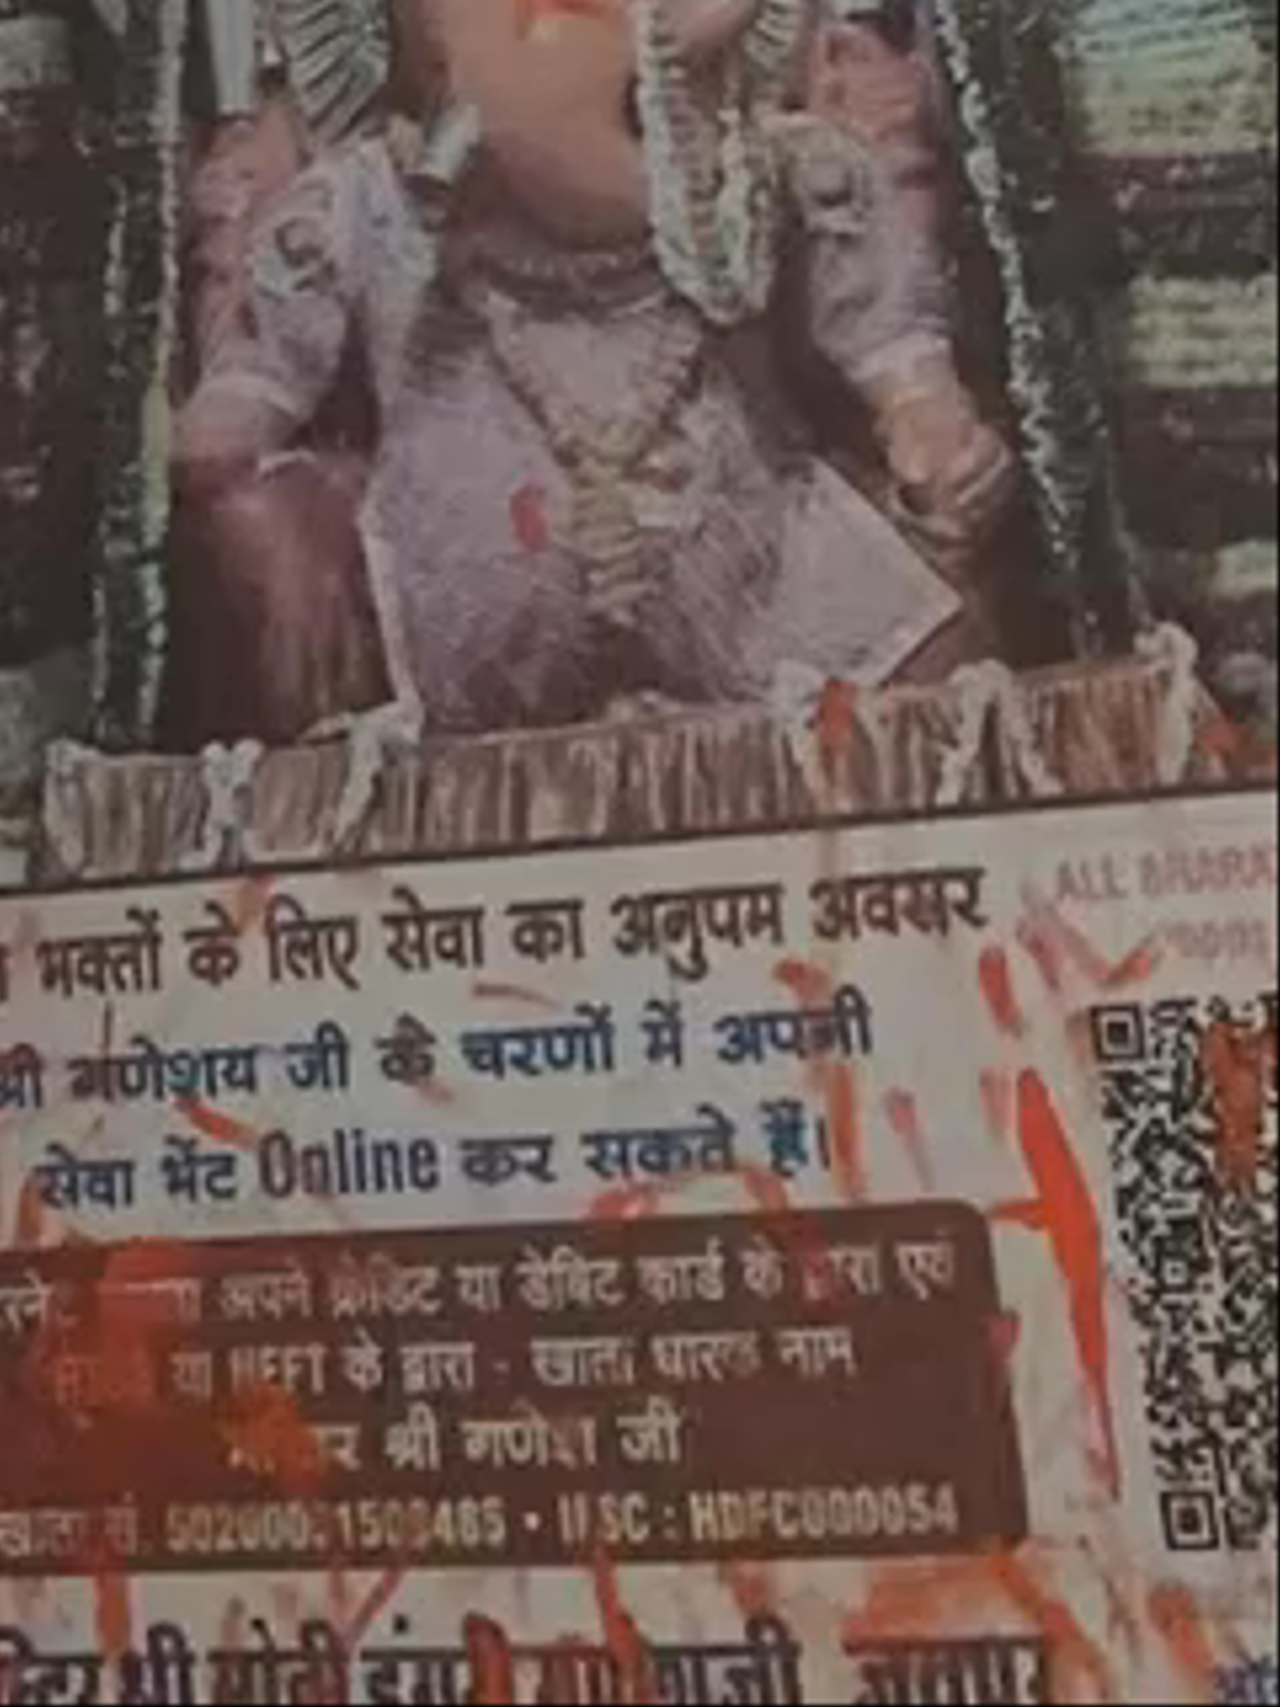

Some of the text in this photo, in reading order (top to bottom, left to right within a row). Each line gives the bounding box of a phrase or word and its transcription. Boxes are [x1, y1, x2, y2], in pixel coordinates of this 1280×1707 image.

[36, 908, 164, 998] भक्तों
[184, 901, 241, 987] के
[264, 895, 362, 990] लिए
[383, 886, 485, 972] सेवा
[507, 898, 585, 963] का
[611, 882, 786, 983] अनुपम
[810, 865, 989, 942] अवसर
[284, 1020, 351, 1090] जी
[372, 1011, 437, 1086] के
[460, 1004, 615, 1080] चरणों
[640, 999, 685, 1069] में
[713, 984, 874, 1067] अपनी
[32, 1144, 136, 1211] सेवा
[160, 1134, 239, 1201] भेंट
[258, 1127, 438, 1200] Online
[460, 1135, 558, 1188] कर
[581, 1104, 737, 1180] सकते
[741, 1234, 785, 1301] के
[343, 1326, 383, 1392] के
[399, 1341, 476, 1395] द्वारा
[775, 1326, 858, 1379] नाम
[385, 1401, 440, 1471] श्री
[616, 1393, 683, 1464] जी
